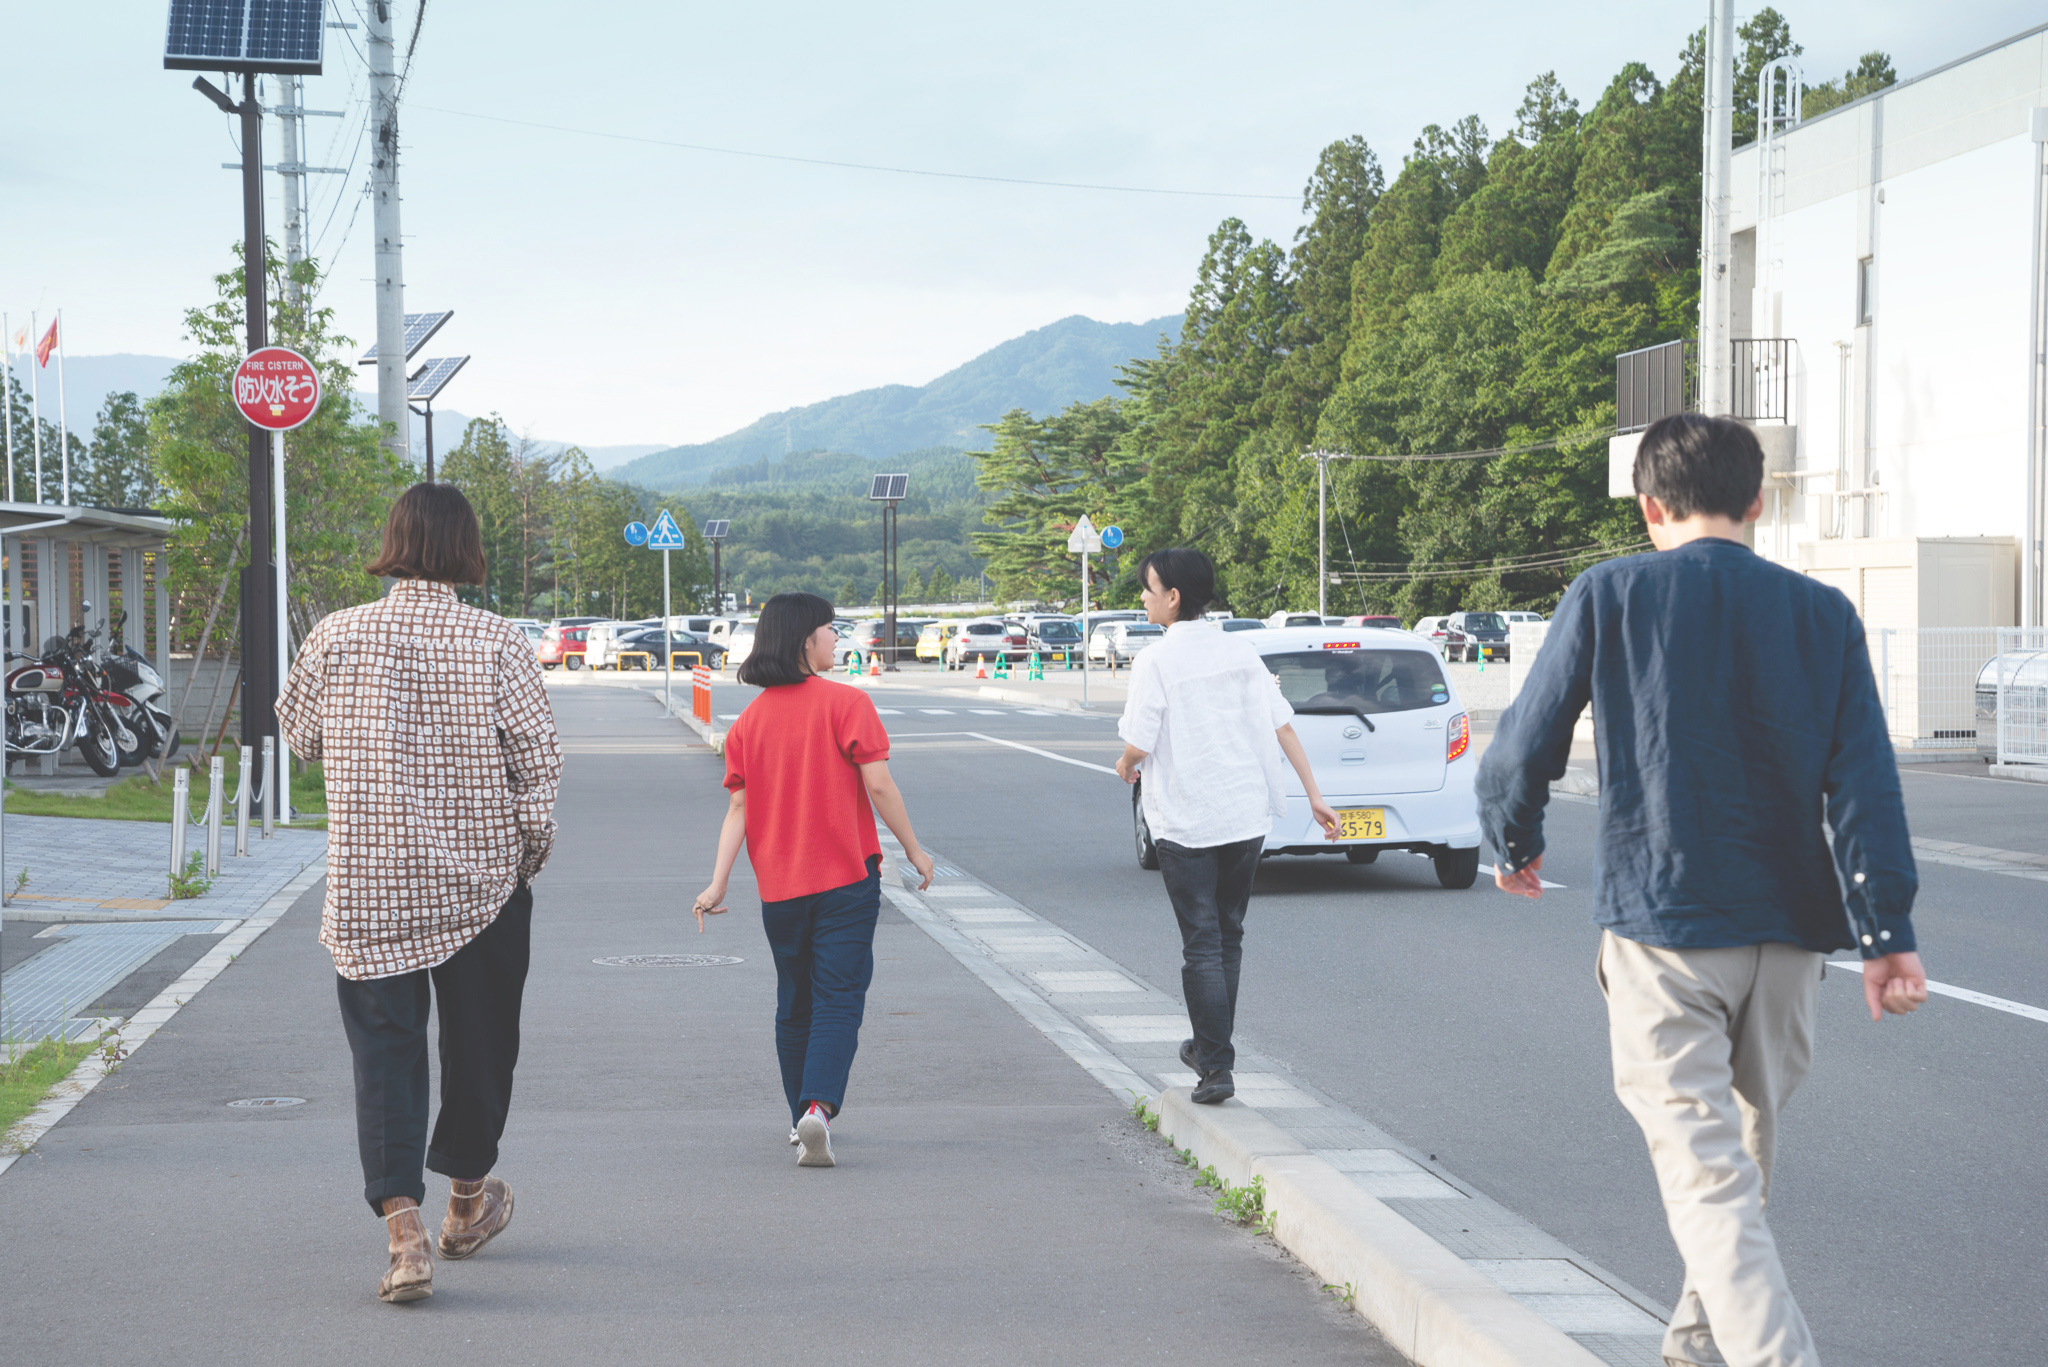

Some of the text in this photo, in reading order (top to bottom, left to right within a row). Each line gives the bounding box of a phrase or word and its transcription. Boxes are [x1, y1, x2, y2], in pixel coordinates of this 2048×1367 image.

[246, 361, 303, 370] FIRE CISTERN
[238, 374, 315, 404] 防火水そう
[1340, 821, 1382, 837] 65-79
